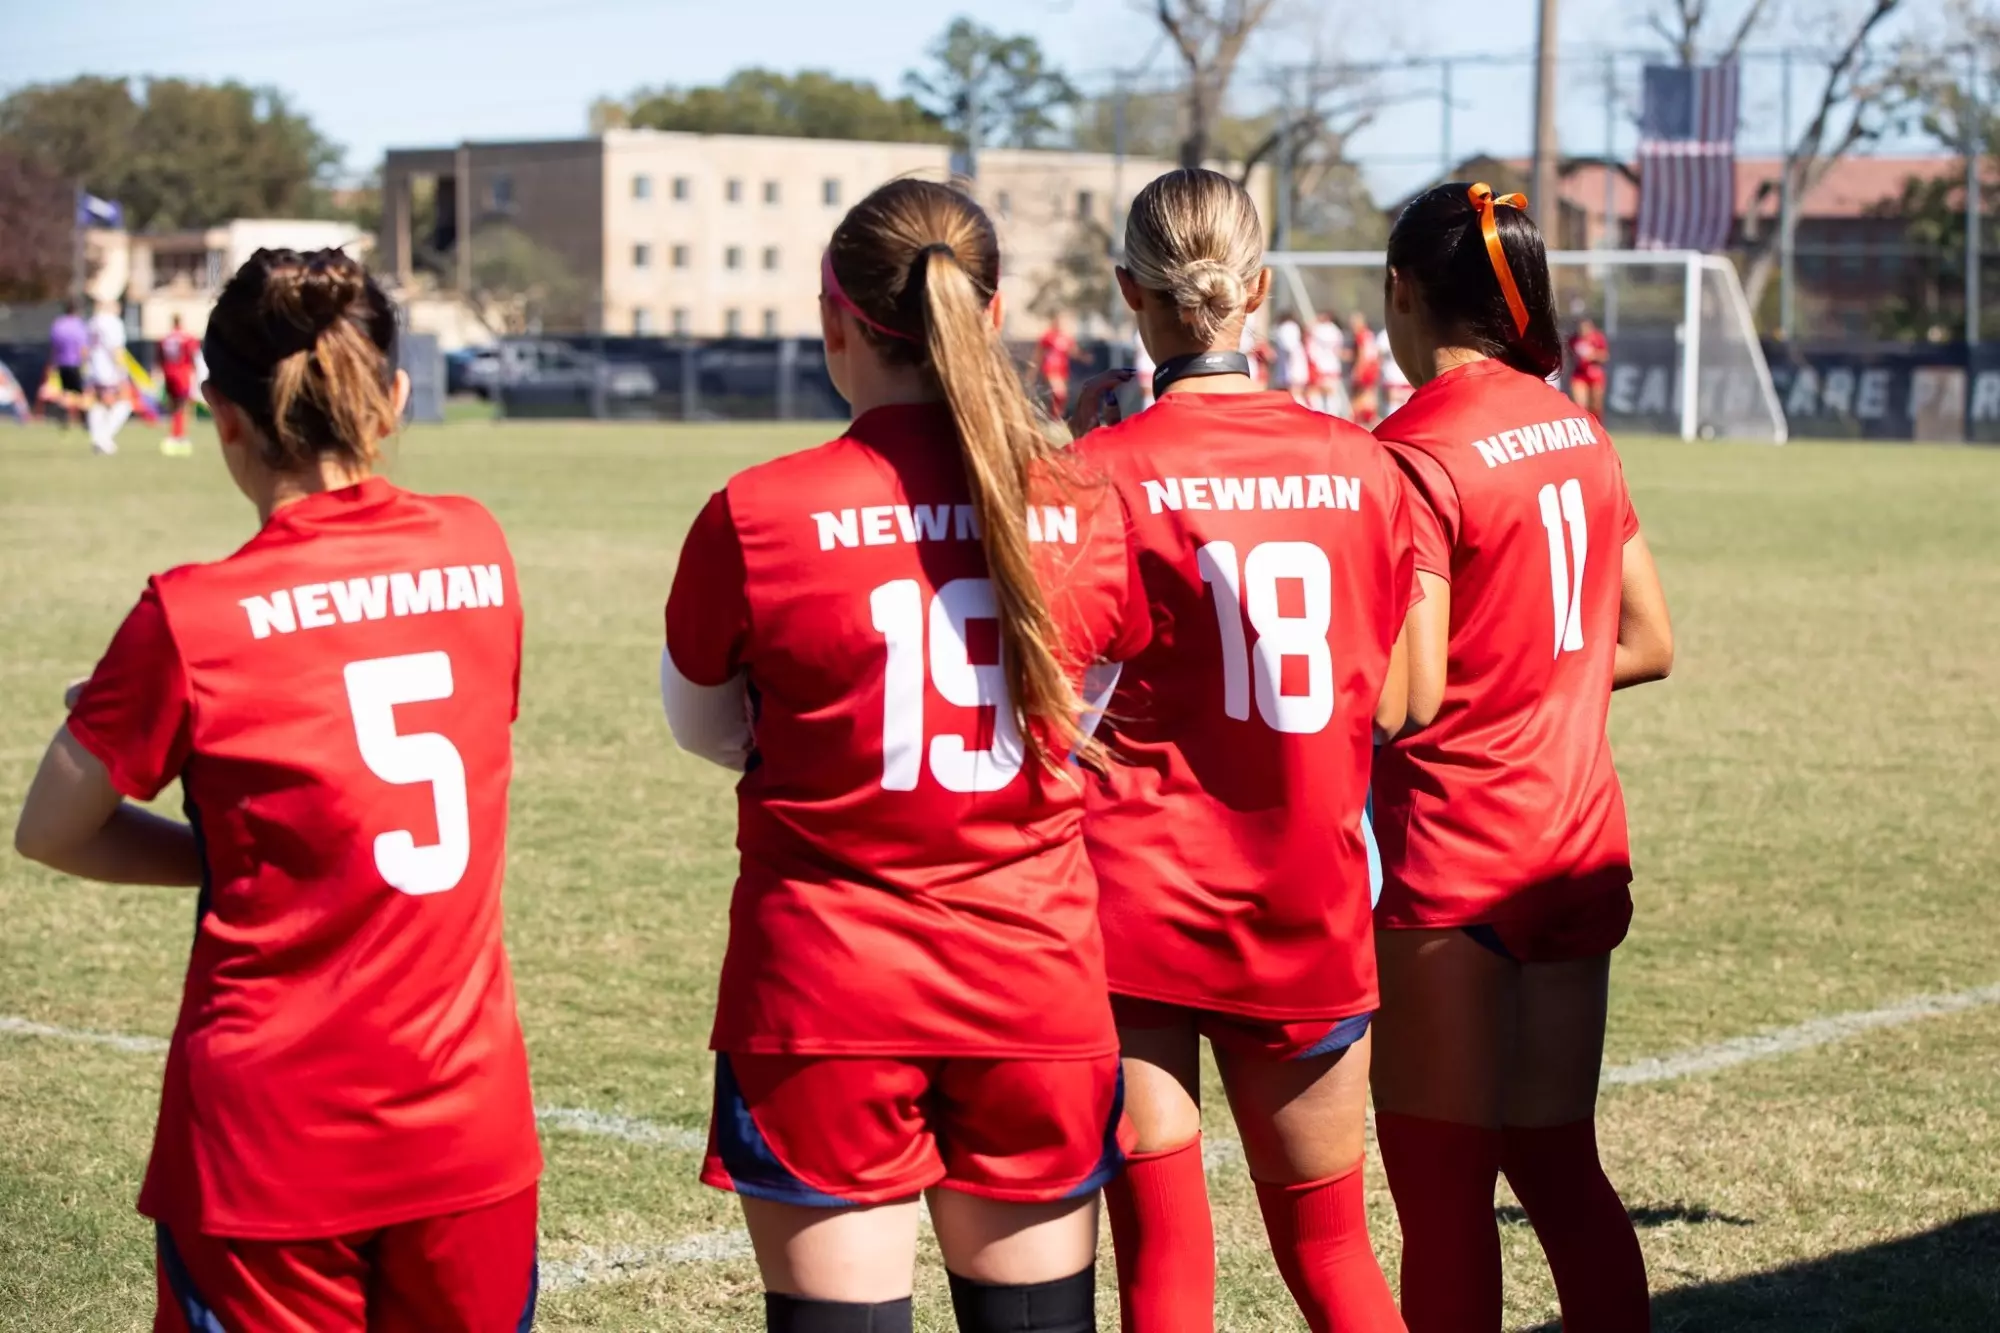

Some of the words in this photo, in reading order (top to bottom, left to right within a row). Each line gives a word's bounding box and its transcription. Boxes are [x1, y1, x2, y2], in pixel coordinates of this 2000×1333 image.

[1140, 474, 1361, 515] NEWMAN
[1471, 416, 1598, 469] NEWMAN
[237, 563, 504, 640] NEWMAN
[1197, 540, 1335, 734] 18
[1537, 478, 1588, 660] 11
[343, 650, 470, 896] 5
[869, 577, 1025, 793] 19
